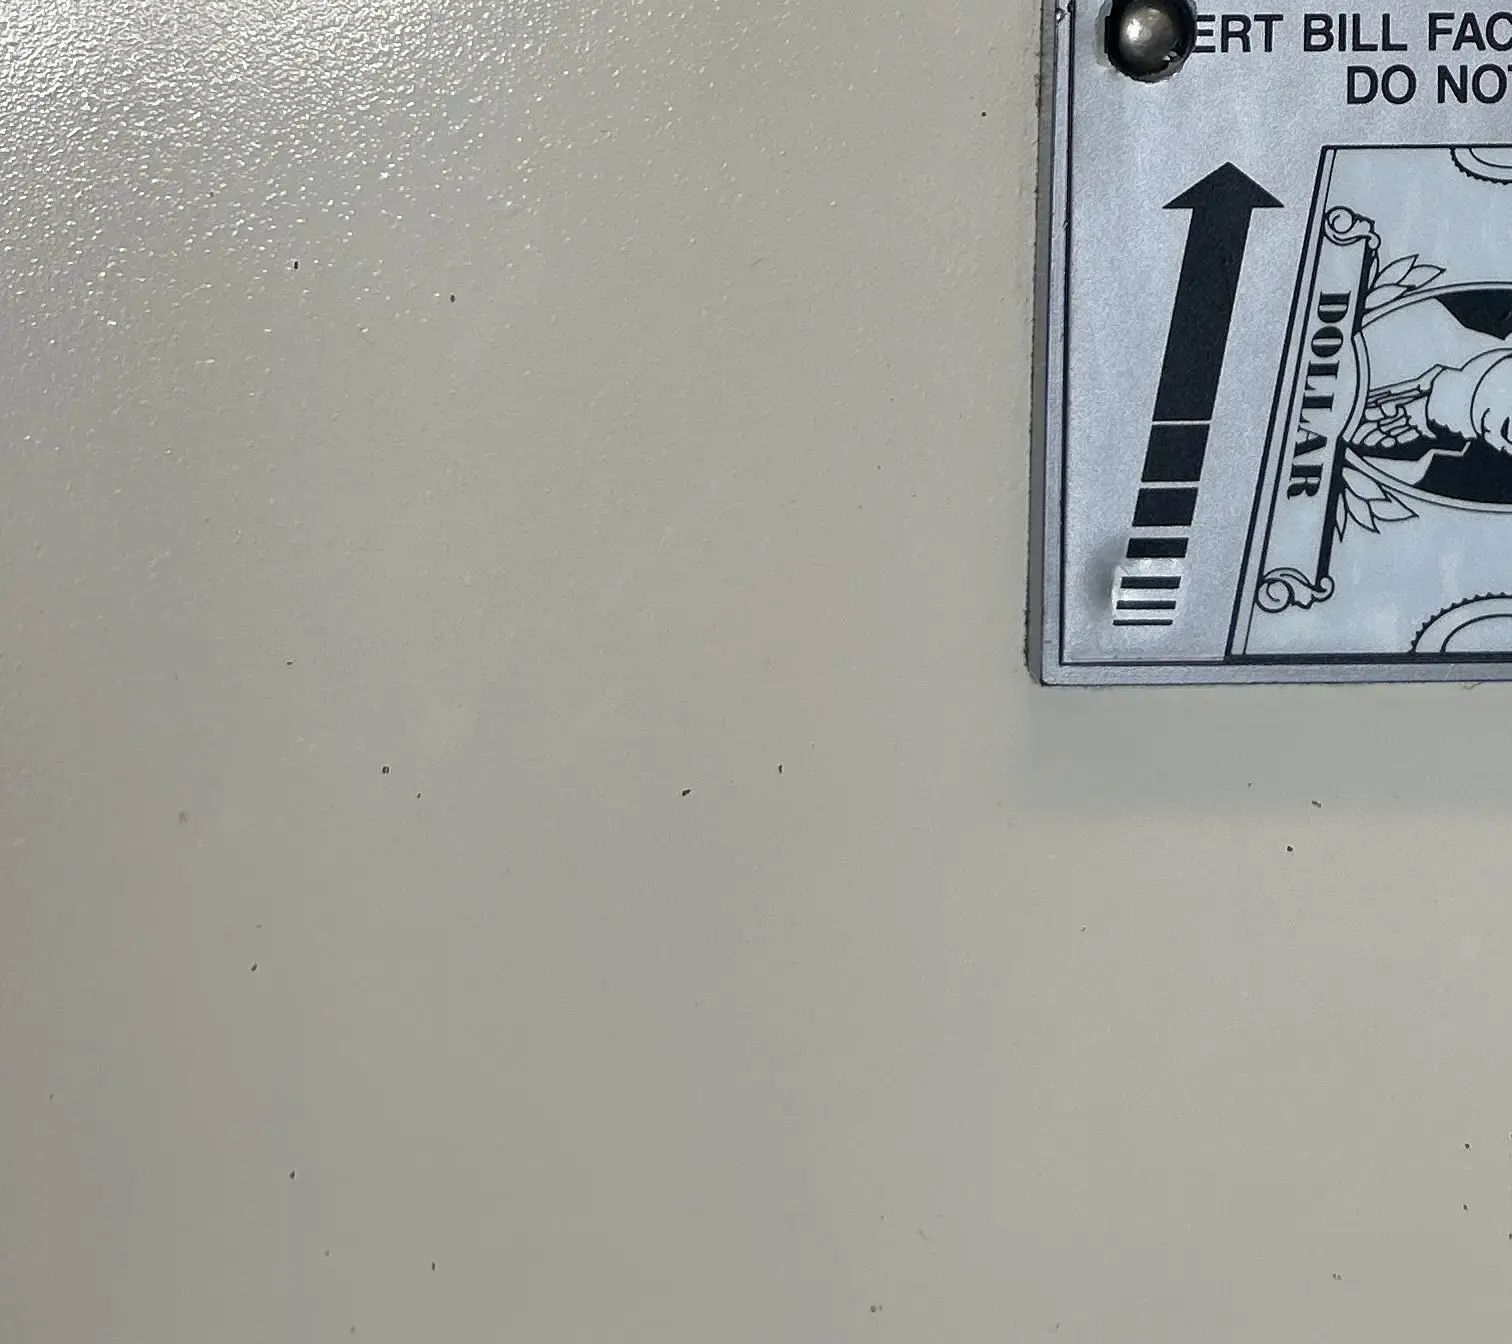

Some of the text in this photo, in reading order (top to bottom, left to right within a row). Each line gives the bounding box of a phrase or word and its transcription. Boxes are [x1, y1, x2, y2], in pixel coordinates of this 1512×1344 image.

[1303, 12, 1408, 53] BILL
[1346, 63, 1417, 105] DO
[1286, 290, 1352, 510] DOLLAR
